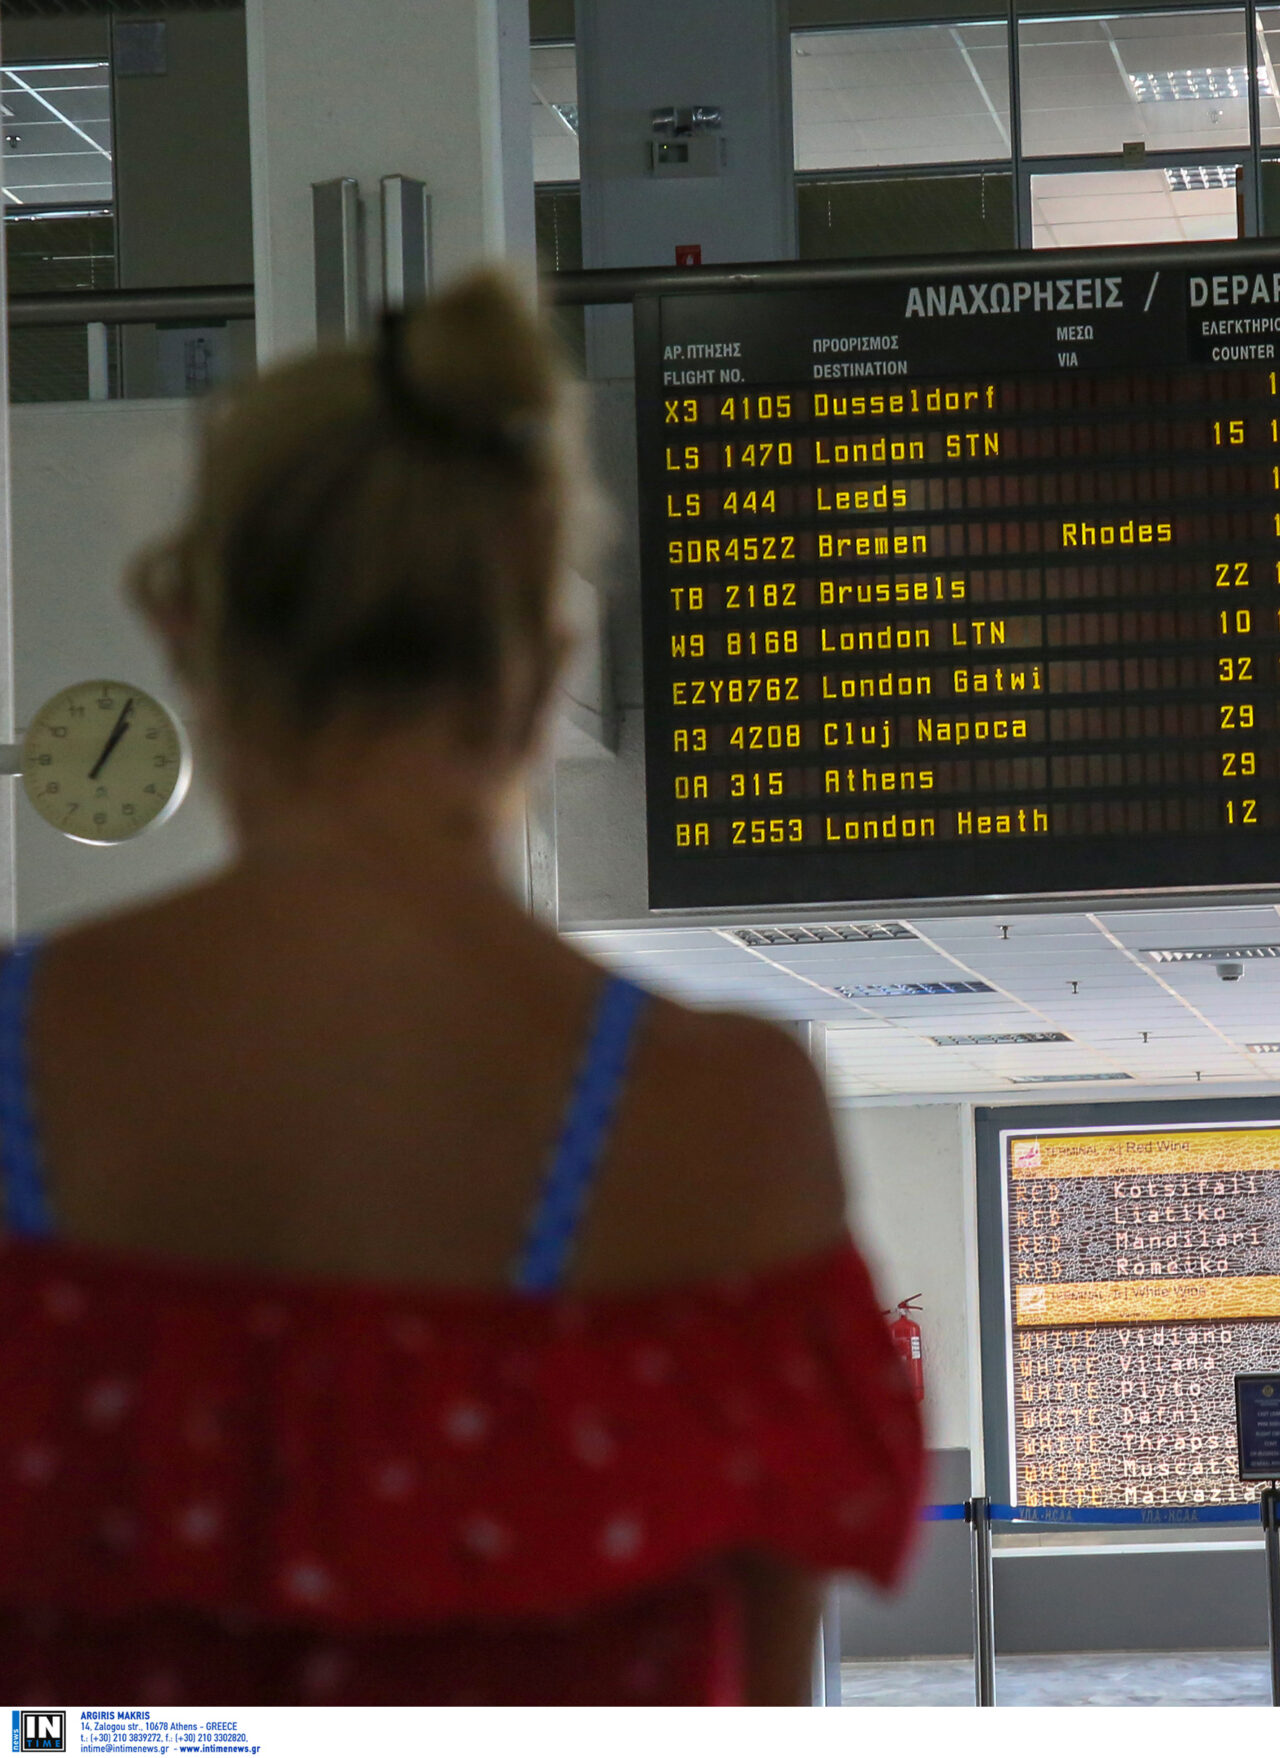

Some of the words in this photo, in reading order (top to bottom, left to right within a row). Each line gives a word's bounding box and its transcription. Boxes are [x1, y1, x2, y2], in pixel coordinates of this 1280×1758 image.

[905, 277, 1123, 317] ΑΝΑΧΩΡΗΣΕΙΣ
[813, 335, 898, 352] ΠΡΟΟΡΙΣΜΟΣ
[1057, 325, 1093, 341] ΜΕΣΩ
[814, 360, 907, 378] DESTINATION
[1058, 352, 1078, 367] VIA
[1212, 344, 1274, 361] COUNTER
[664, 370, 715, 385] FLIGHT
[720, 369, 744, 383] NO.
[665, 399, 698, 423] X3
[720, 395, 791, 421] 4105
[814, 385, 994, 417] Dusseldorf
[666, 446, 699, 471] LS
[724, 442, 792, 468] 1470
[815, 437, 924, 464] London
[946, 432, 999, 458] STN
[1213, 420, 1244, 445] 15
[667, 493, 700, 517] LS
[723, 489, 776, 515] 444
[817, 484, 907, 511] Leeds
[669, 535, 796, 564] SDR4522
[818, 534, 927, 558] Bremen
[1062, 520, 1172, 547] Rhodes
[670, 587, 703, 611] TB
[725, 583, 797, 609] 2182
[819, 576, 966, 605] Brussels
[1215, 562, 1249, 587] 22
[671, 634, 704, 658] W9
[727, 629, 798, 656] 8168
[821, 625, 930, 652] London
[952, 620, 1005, 646] LTN
[1220, 609, 1251, 635] 10
[672, 677, 800, 705] EZY8762
[822, 672, 931, 699] London
[953, 666, 1041, 693] Gatwi
[1218, 656, 1253, 682] 32
[673, 728, 707, 752] A3
[729, 724, 801, 750] 4208
[824, 720, 890, 749] Cluj
[917, 718, 1027, 746] Napoca
[1220, 704, 1254, 729] 29
[730, 771, 783, 797] 315
[825, 768, 934, 793] Athens
[1222, 751, 1256, 777] 29
[676, 822, 709, 847] BA
[731, 818, 803, 845] 2553
[826, 814, 935, 841] London
[957, 808, 1048, 835] Heath
[1226, 799, 1257, 824] 12
[1126, 1141, 1153, 1154] Red
[1156, 1140, 1191, 1153] Wine
[1114, 1175, 1259, 1199] Kotsifali
[1115, 1203, 1226, 1225] Liatiko
[1116, 1227, 1260, 1250] Mandilari
